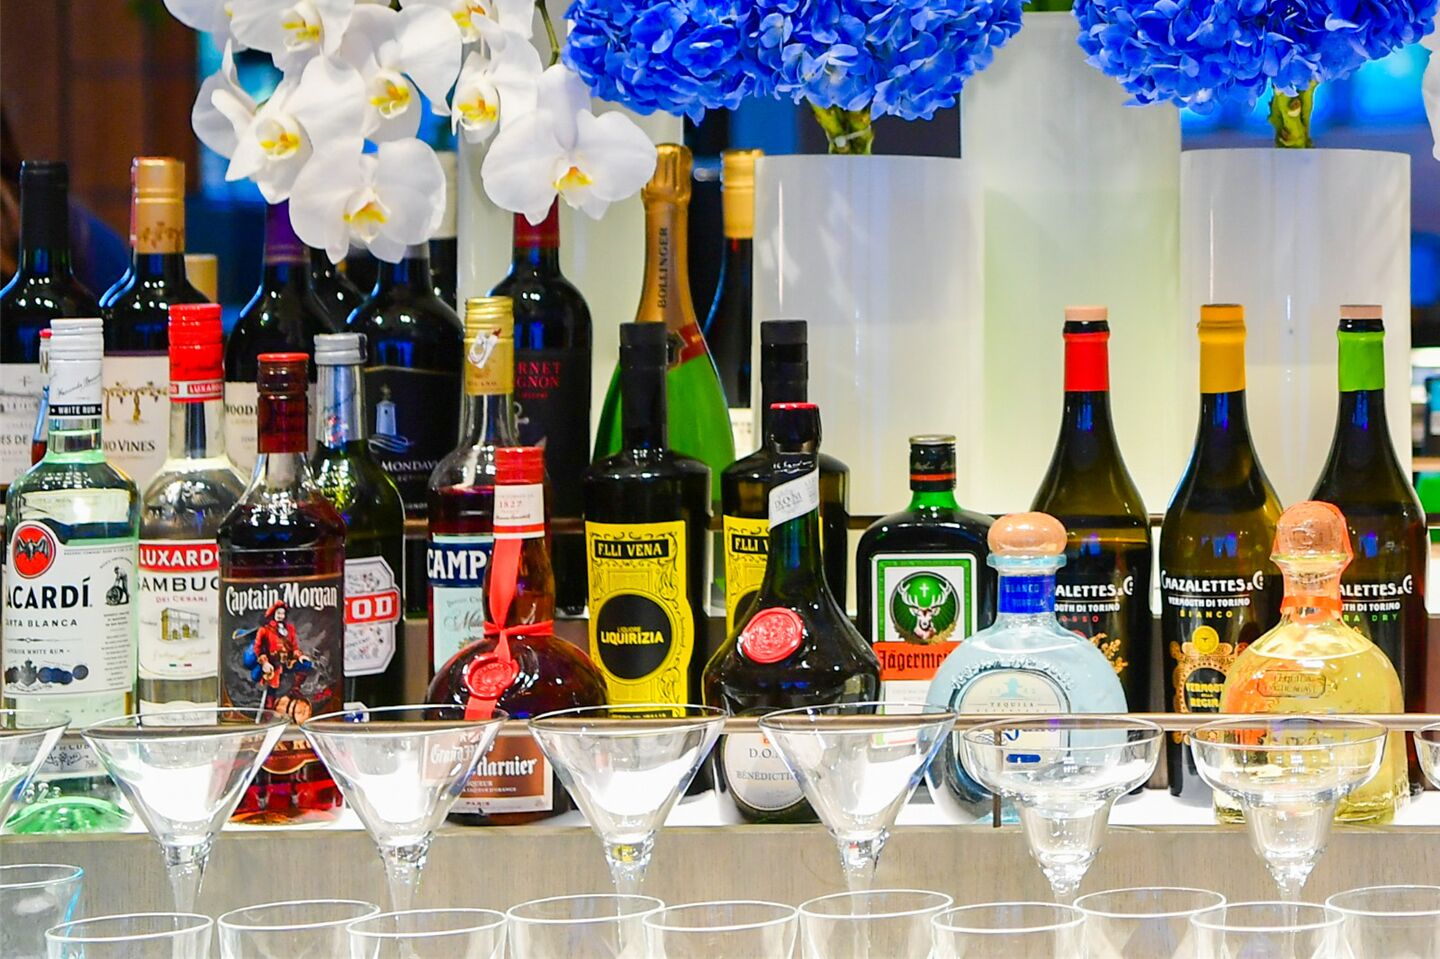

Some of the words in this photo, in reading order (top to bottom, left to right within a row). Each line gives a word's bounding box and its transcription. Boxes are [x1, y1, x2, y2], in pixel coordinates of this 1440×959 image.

[657, 227, 669, 309] BOLLINGER
[57, 405, 81, 415] WHITE
[82, 405, 97, 414] RUM
[116, 440, 156, 452] VINES
[626, 542, 663, 557] VENA
[140, 548, 220, 567] LUXARD
[427, 547, 491, 580] CAMP
[226, 584, 279, 617] Captain
[279, 582, 338, 612] Morgan
[1168, 596, 1205, 608] VERMOUTH
[1205, 598, 1216, 608] DI
[1217, 597, 1251, 608] TORINO
[1076, 604, 1087, 613] DI
[1088, 602, 1120, 613] TORINO
[1369, 602, 1401, 612] TORINO
[1180, 609, 1234, 619] BIANCO
[1371, 613, 1398, 622] DRY
[27, 618, 78, 628] BLANCA
[600, 631, 665, 646] LIQUIRIZIA
